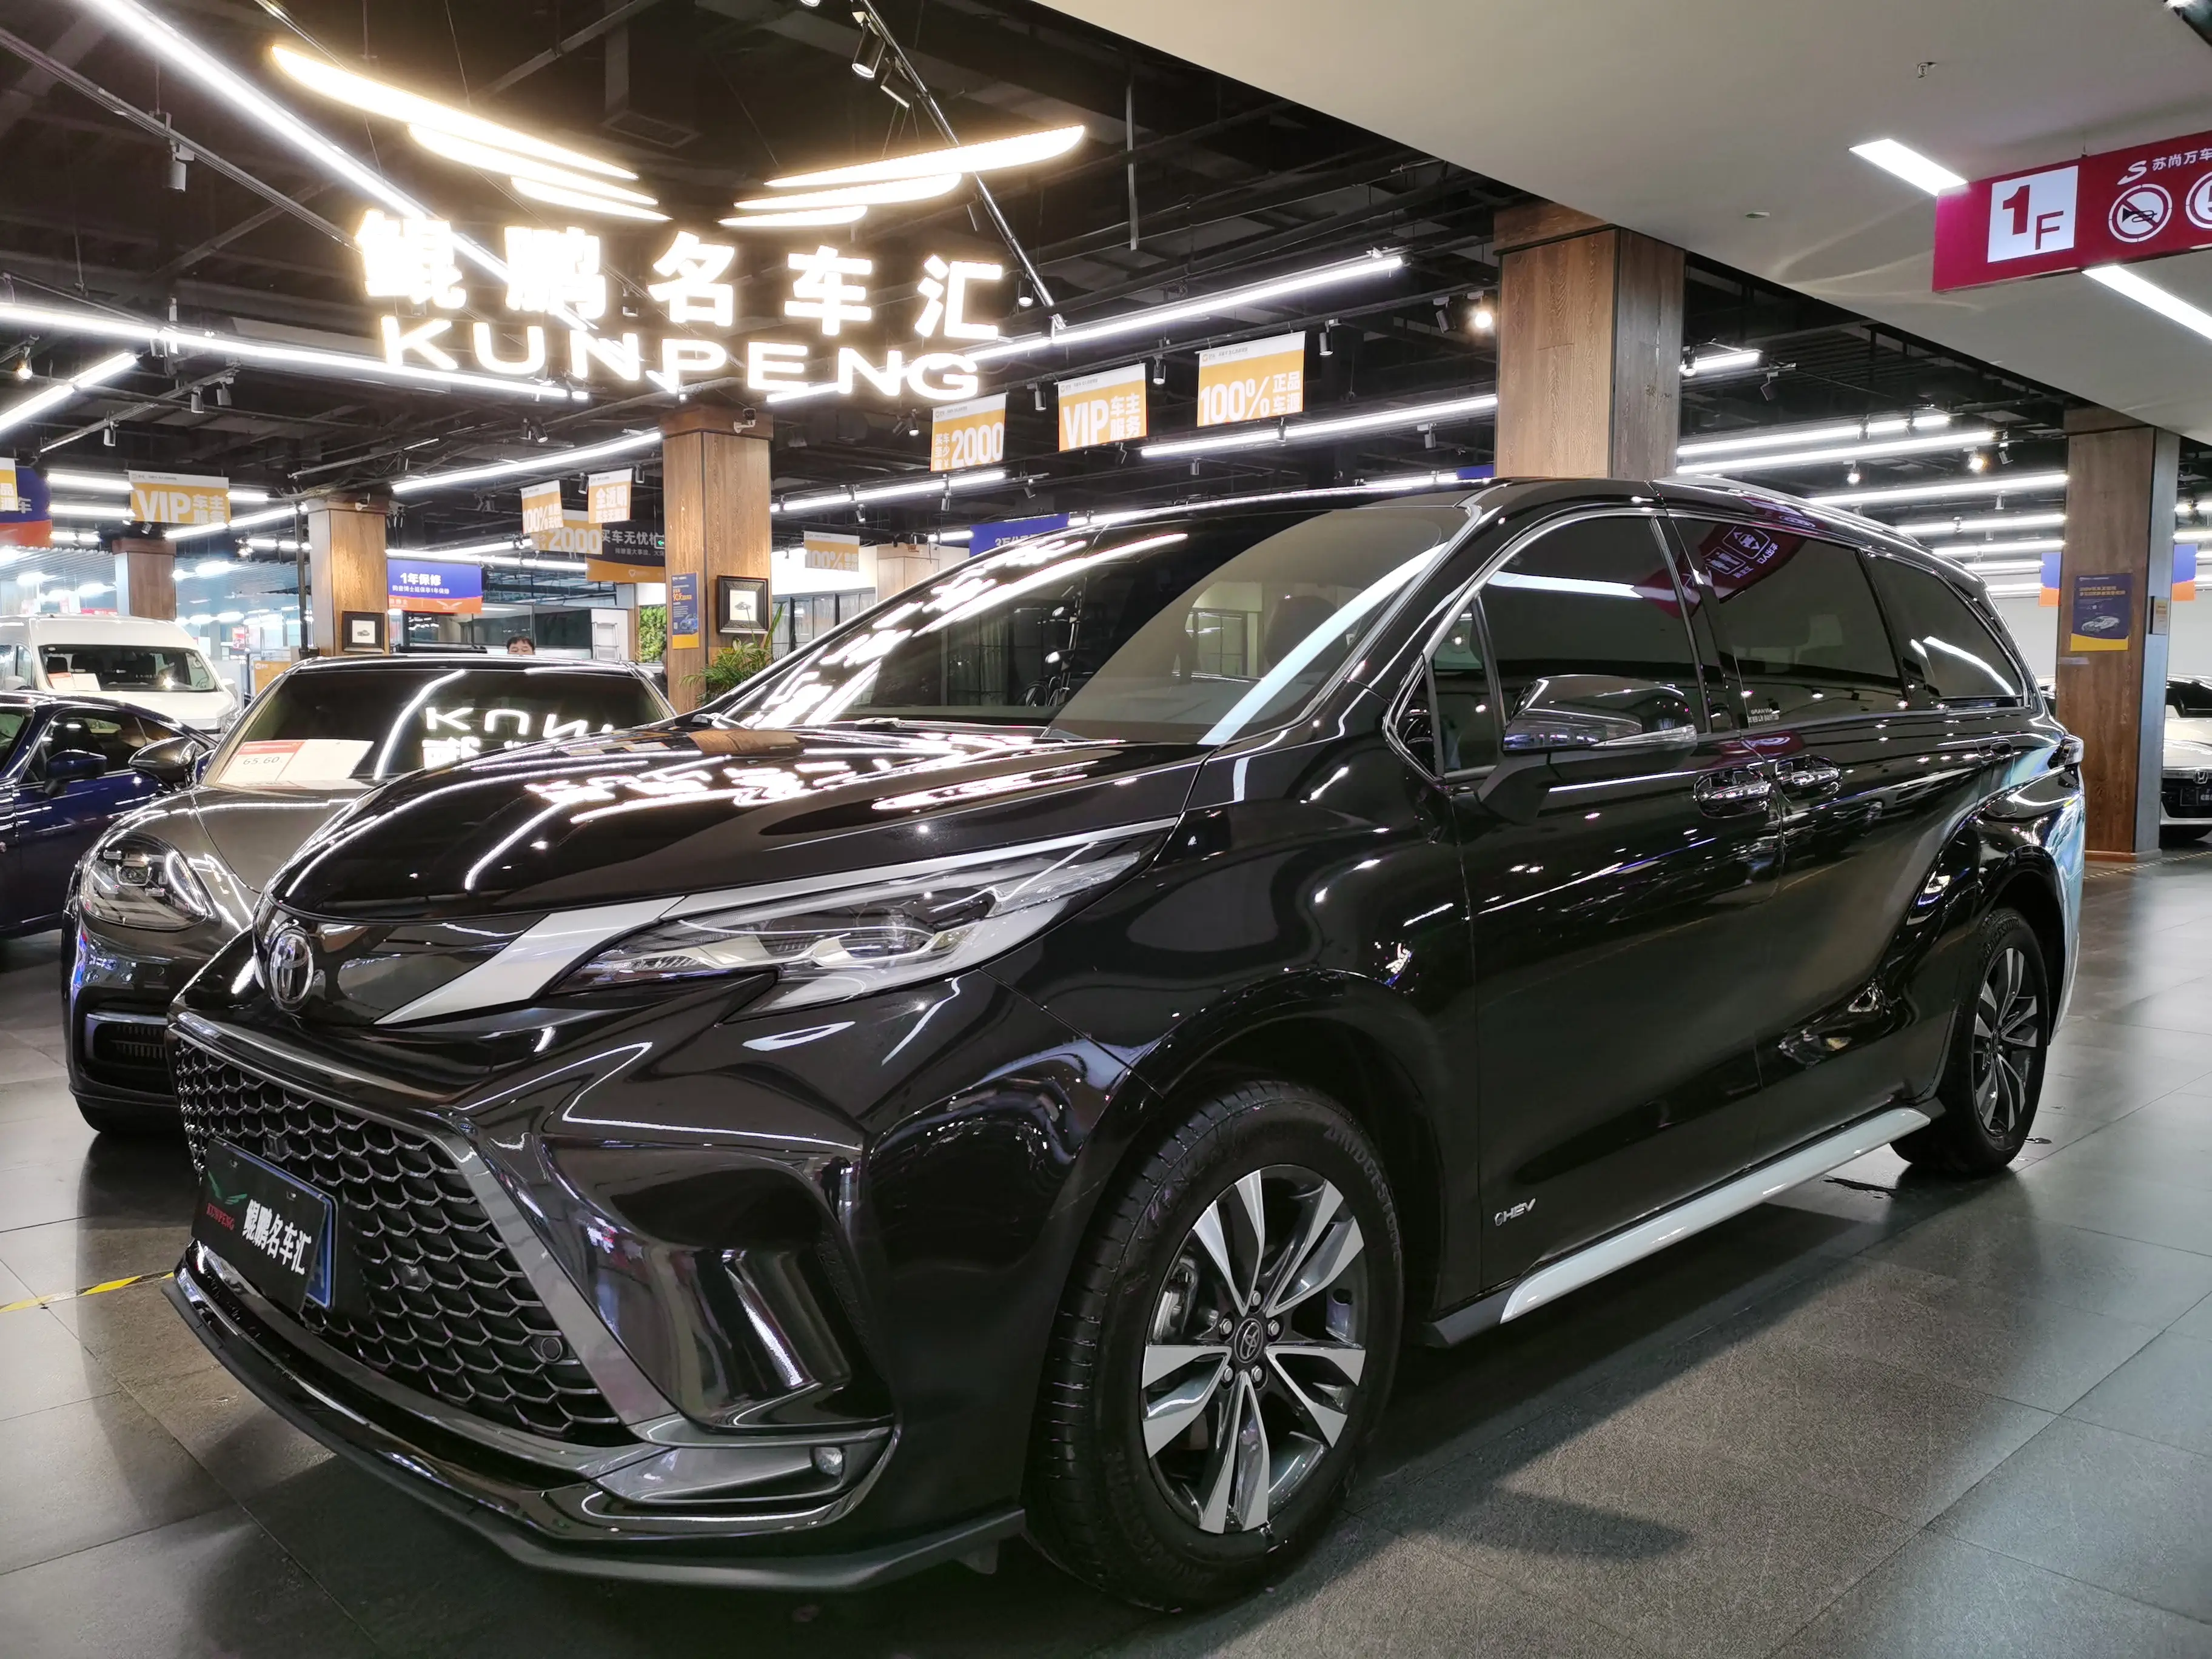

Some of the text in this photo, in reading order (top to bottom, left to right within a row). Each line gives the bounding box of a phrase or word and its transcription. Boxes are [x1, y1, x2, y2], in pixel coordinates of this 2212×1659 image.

[355, 209, 1004, 341] 鲲鹏名车汇
[381, 314, 979, 401] KUNPENG
[1063, 393, 1141, 449] VIP 车主
[1201, 370, 1301, 425] 100% 正品
[951, 421, 1004, 469] 2000
[1110, 415, 1141, 441] 服务
[135, 490, 191, 522] VIP
[400, 572, 441, 586] 1年保修
